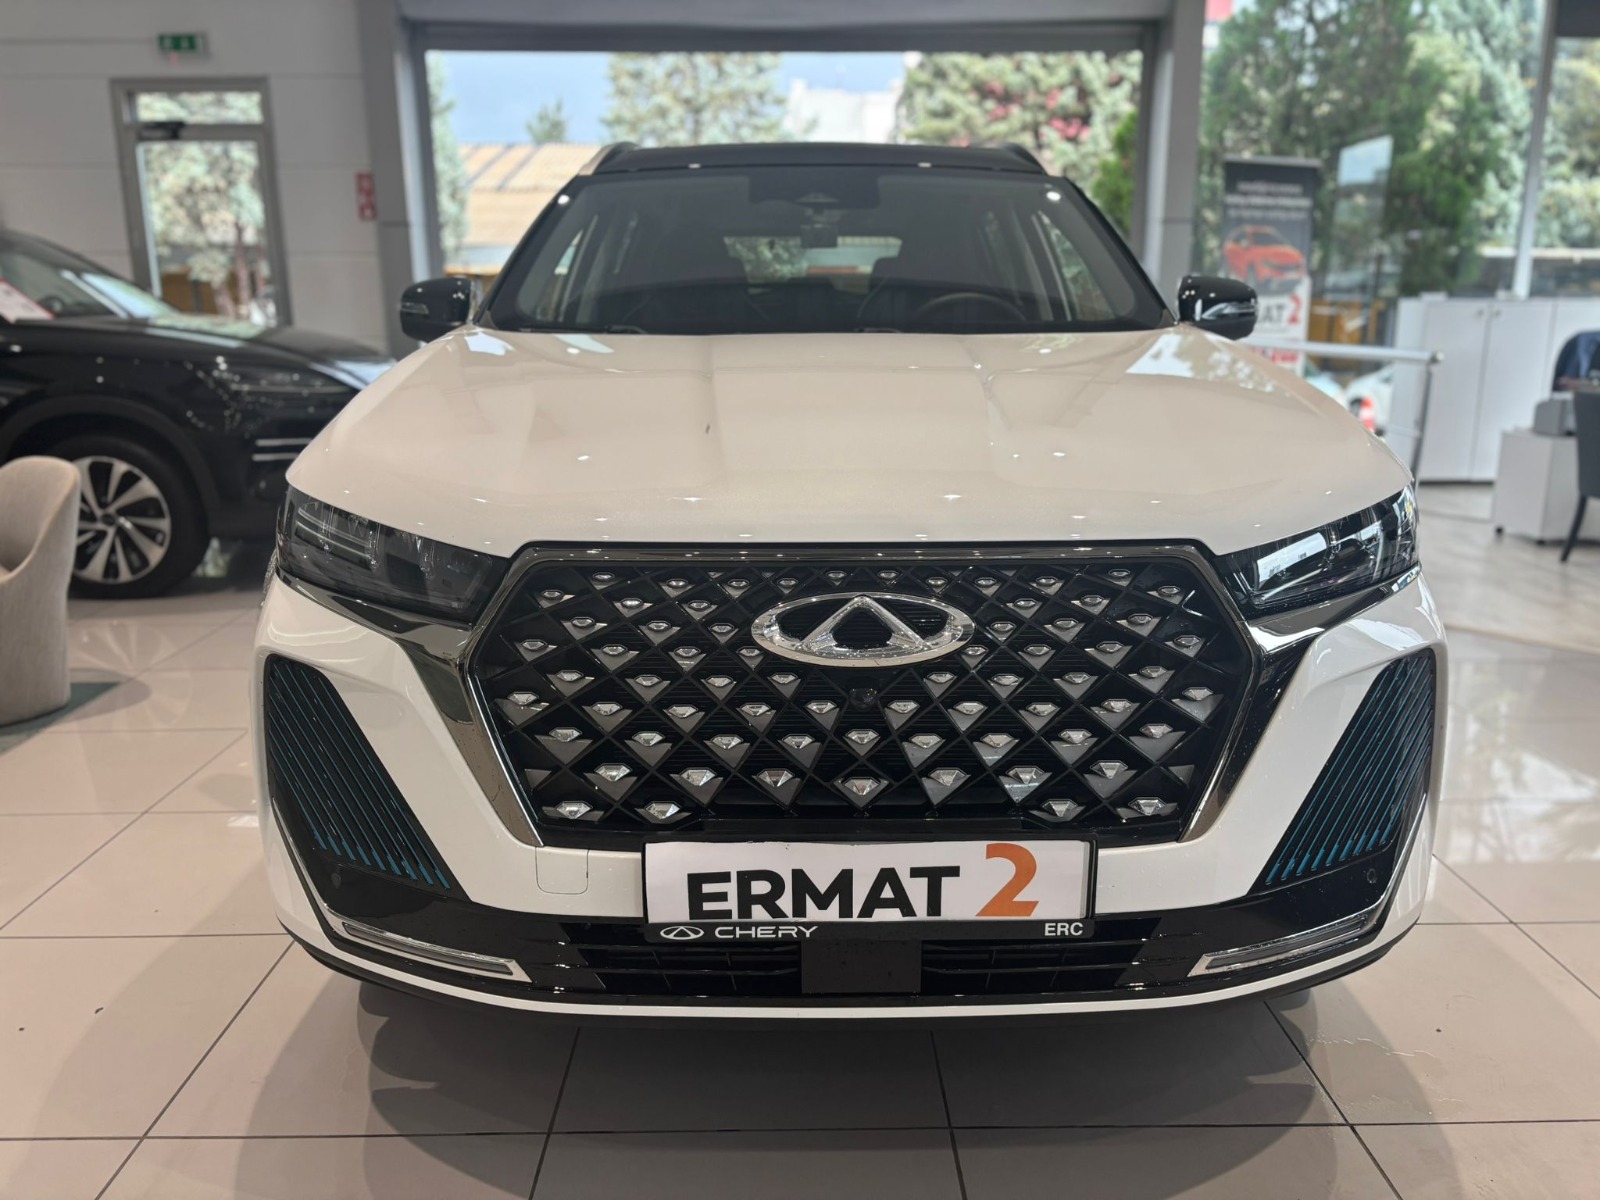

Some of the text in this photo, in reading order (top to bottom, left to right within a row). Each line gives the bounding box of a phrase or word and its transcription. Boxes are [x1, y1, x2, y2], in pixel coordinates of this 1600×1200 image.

[1257, 293, 1302, 325] AT 2
[687, 842, 1040, 920] ERMAT 2
[714, 925, 818, 939] CHERY
[1044, 922, 1084, 937] ERC
